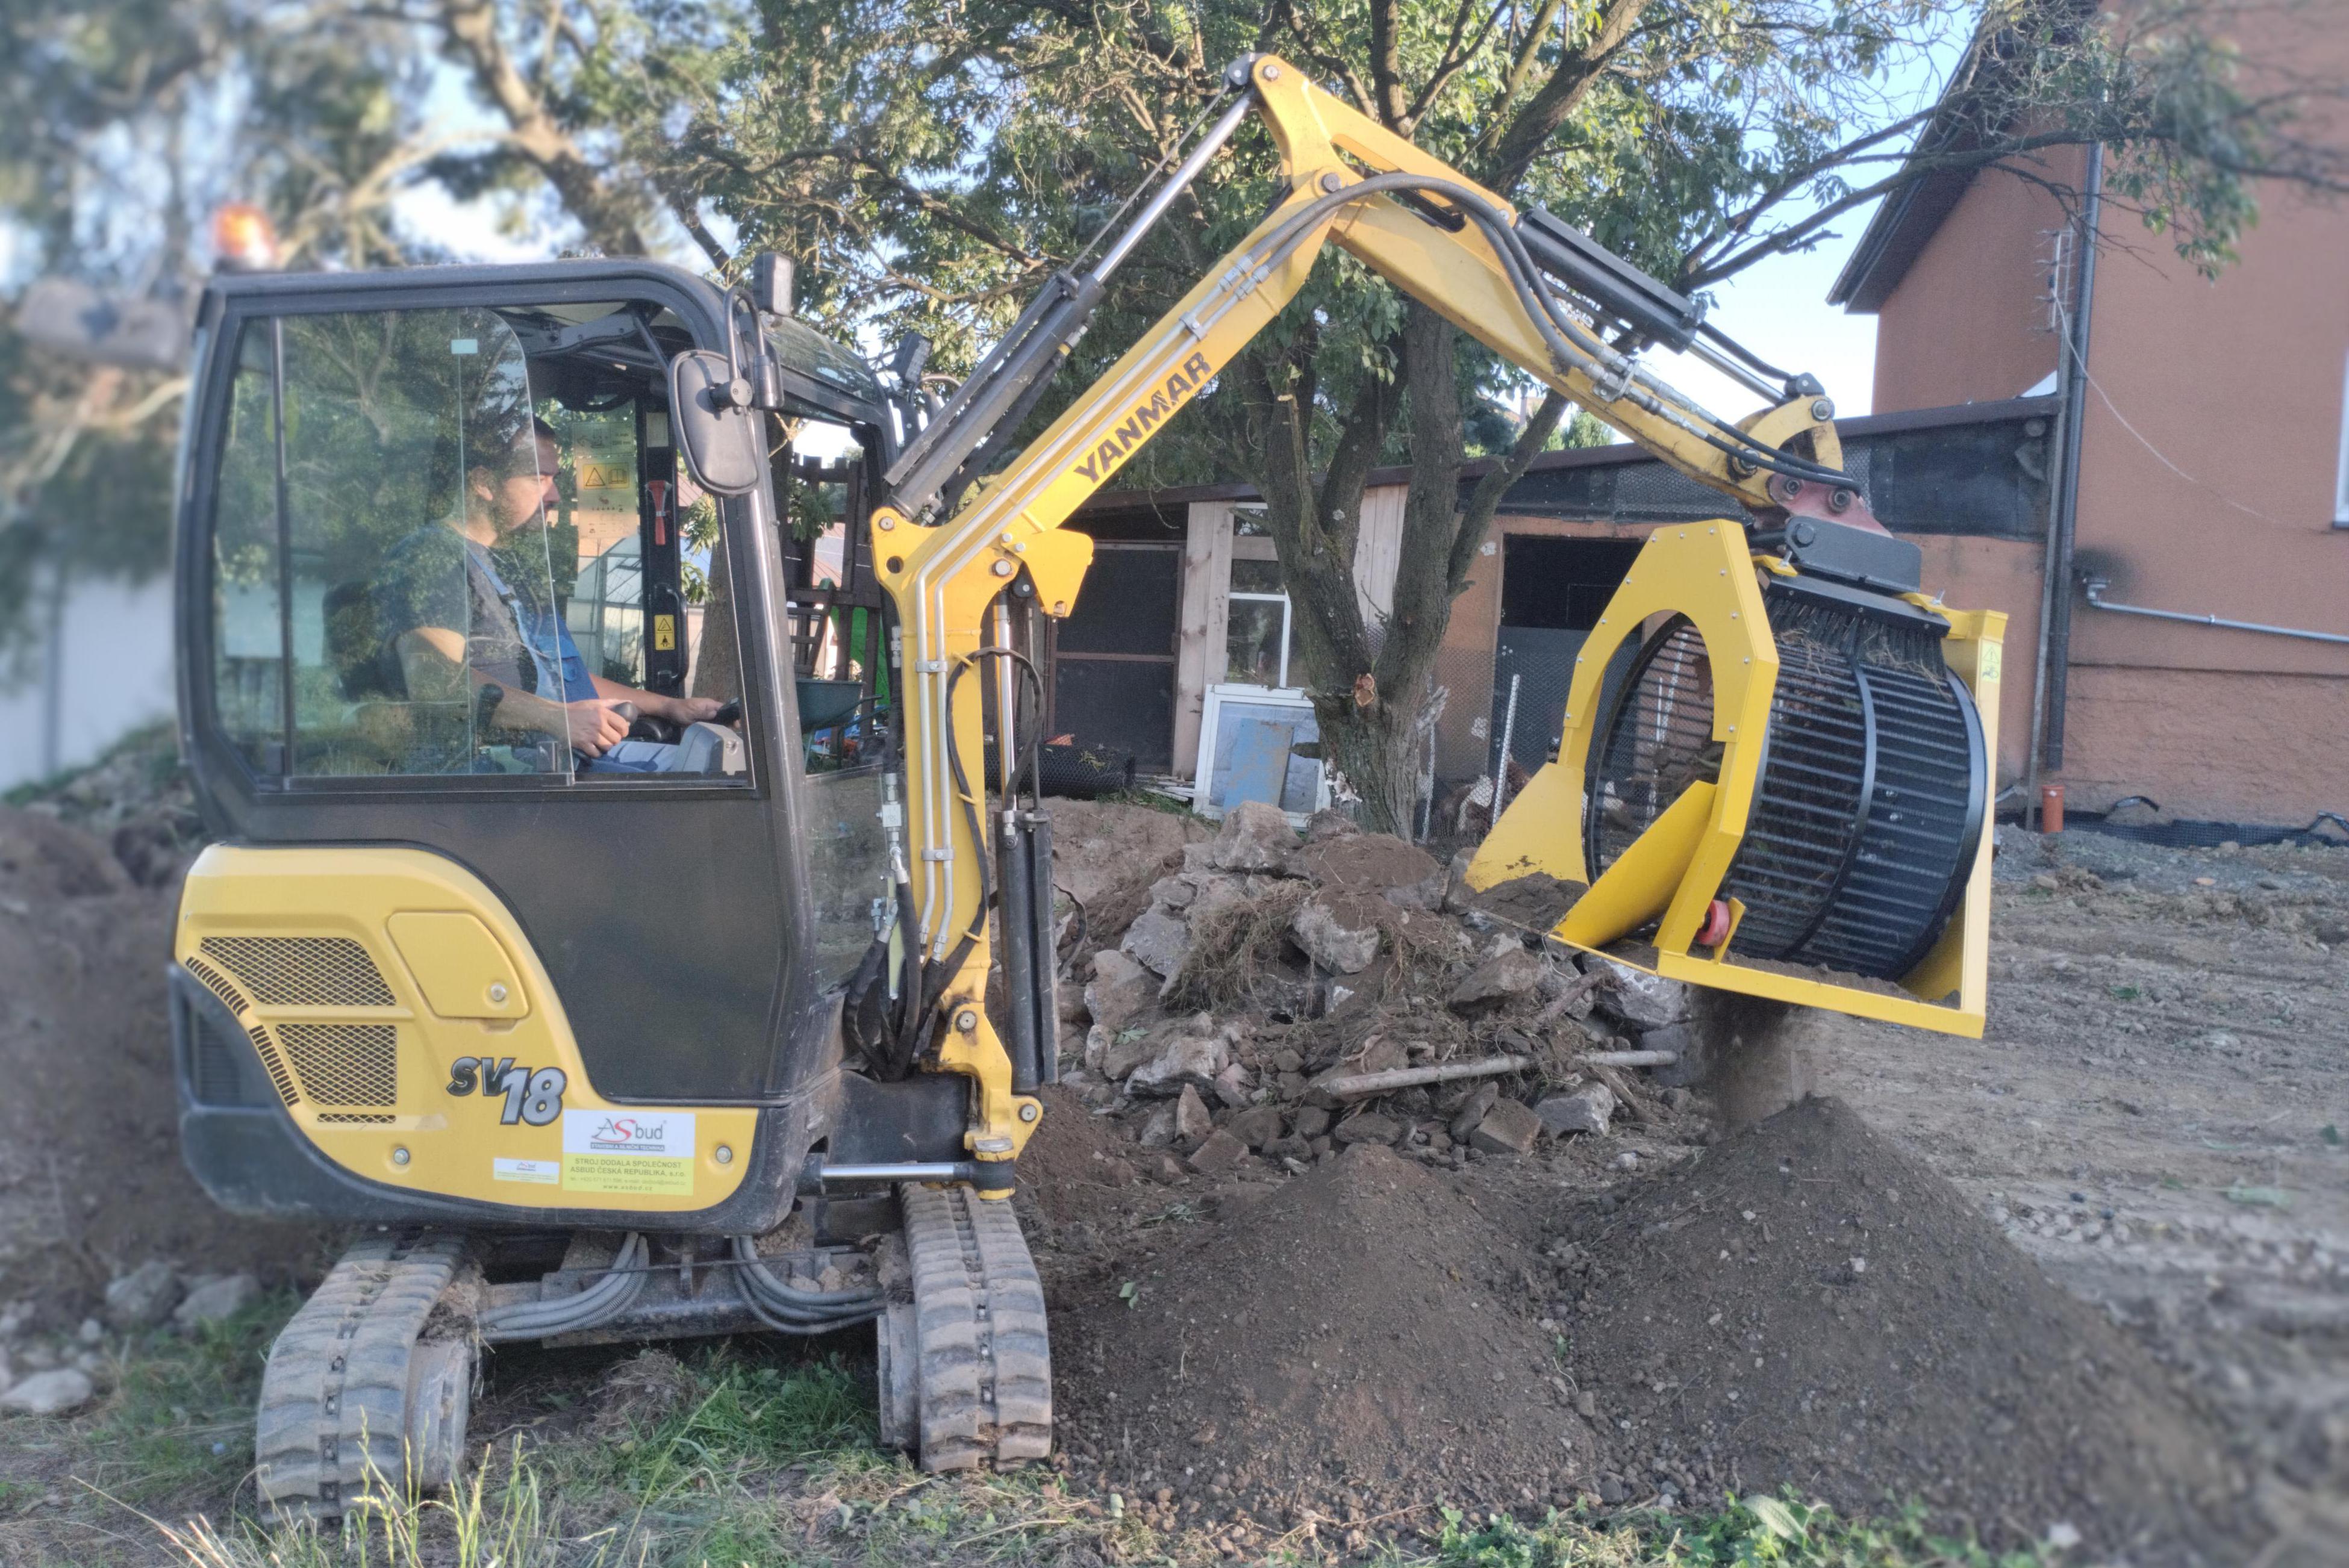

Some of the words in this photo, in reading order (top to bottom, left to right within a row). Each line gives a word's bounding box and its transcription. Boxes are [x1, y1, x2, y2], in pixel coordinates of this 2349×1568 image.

[1073, 351, 1212, 484] YANMAR
[632, 1159, 682, 1168] SPOLEČNOST
[597, 1166, 622, 1174] ČESKÁ
